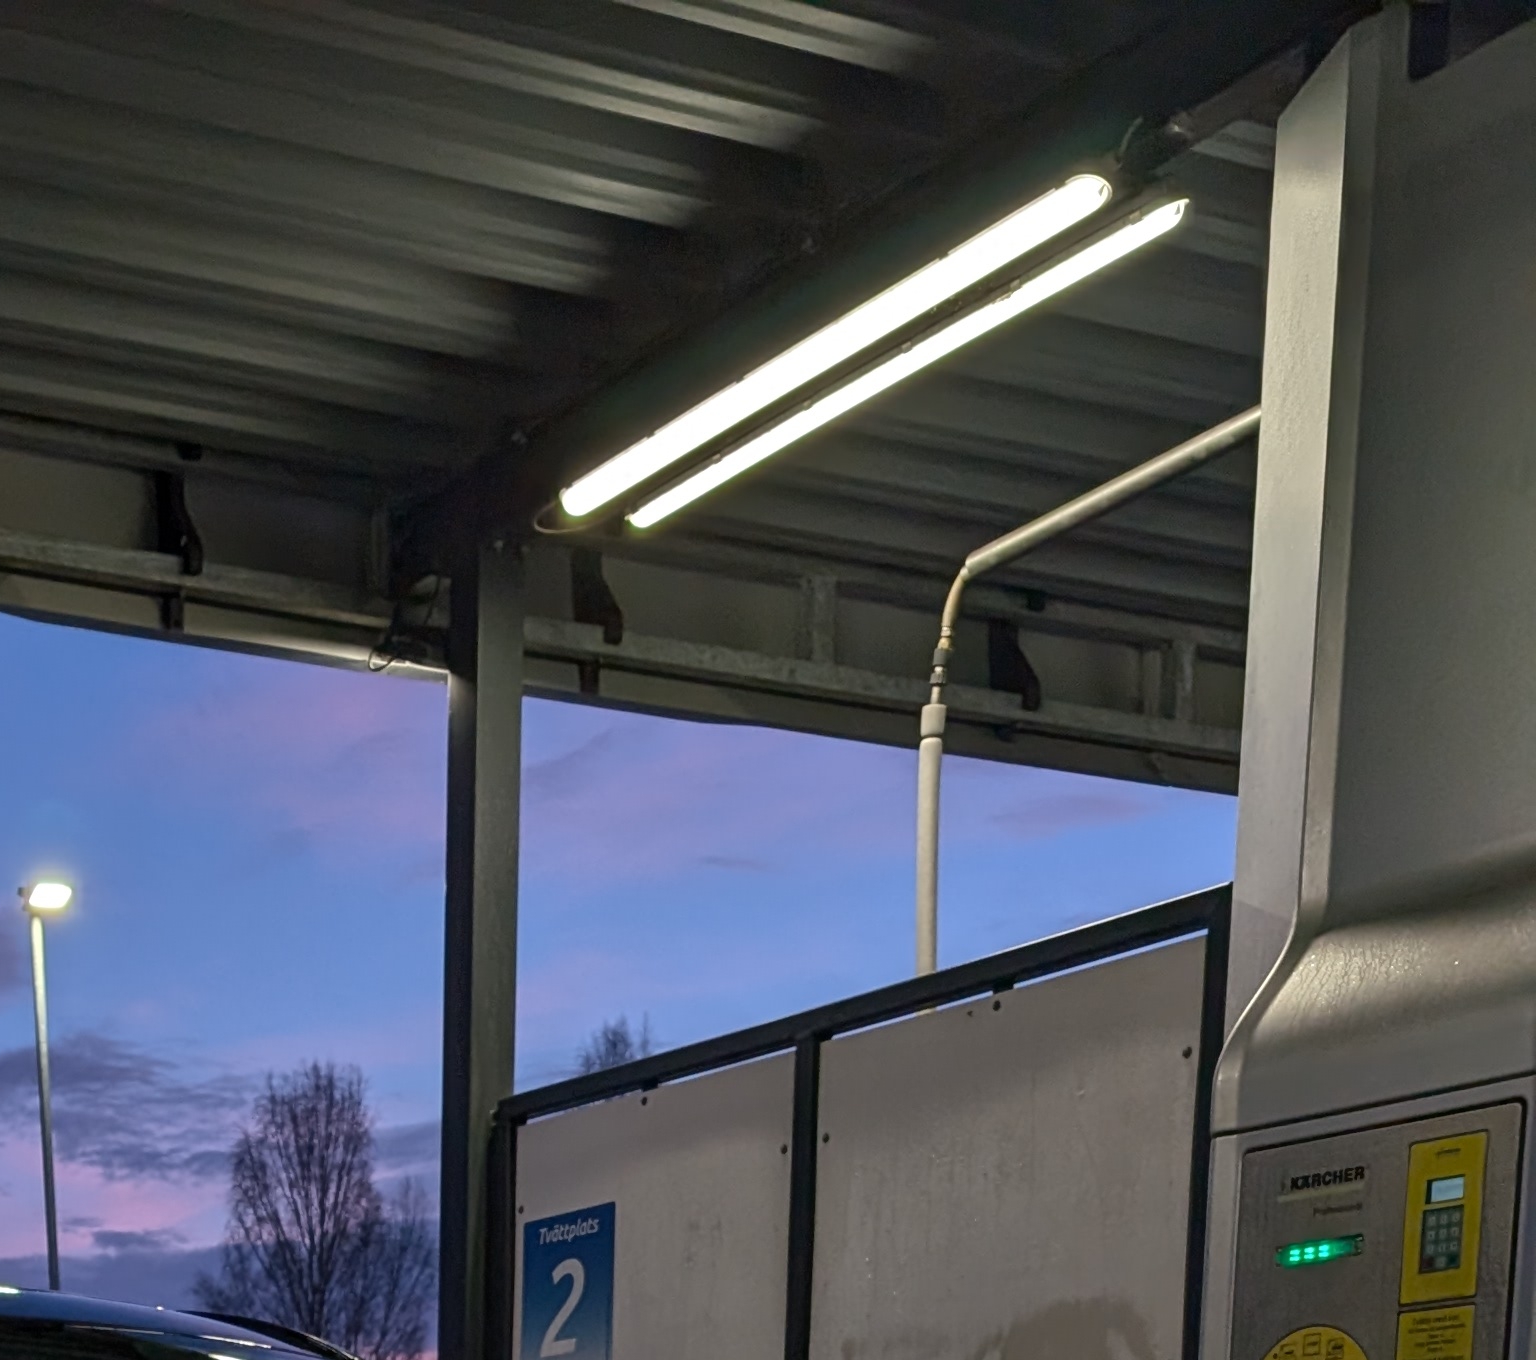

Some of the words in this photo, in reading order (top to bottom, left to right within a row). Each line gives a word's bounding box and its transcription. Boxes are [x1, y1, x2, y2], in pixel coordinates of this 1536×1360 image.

[1290, 1165, 1365, 1190] KÄRCHER
[539, 1218, 599, 1245] Tvättplats
[539, 1258, 585, 1358] 2
